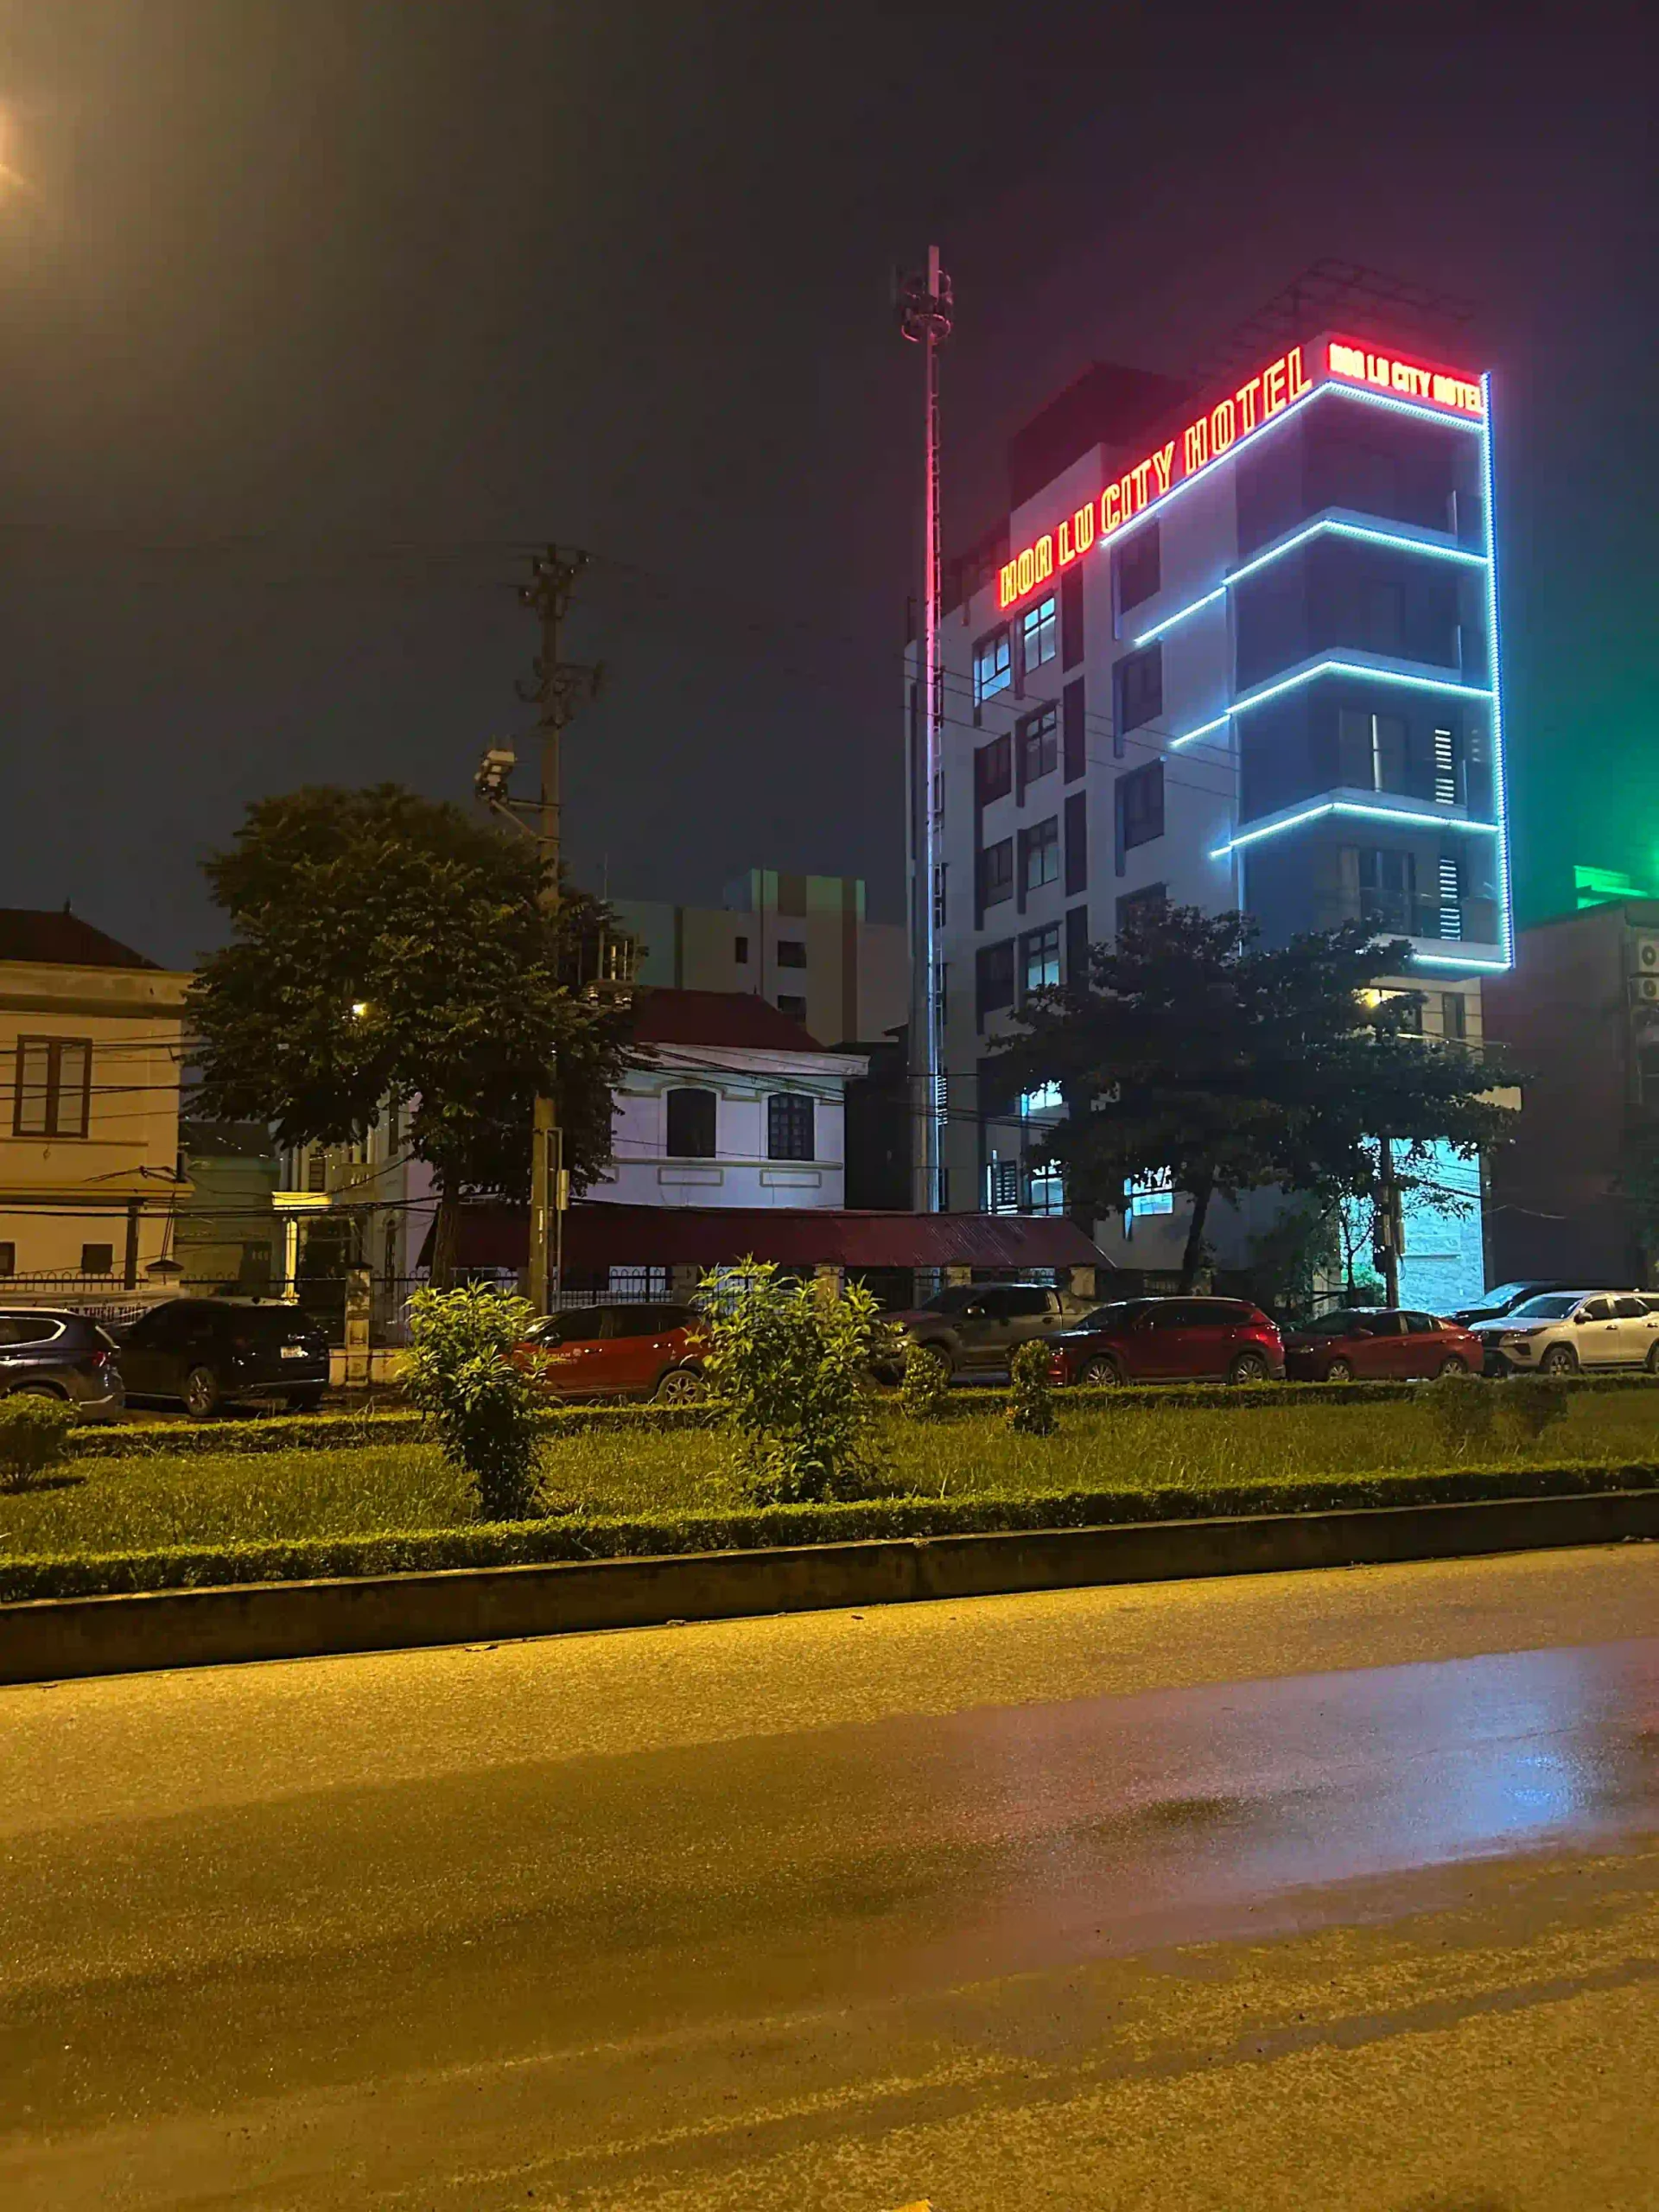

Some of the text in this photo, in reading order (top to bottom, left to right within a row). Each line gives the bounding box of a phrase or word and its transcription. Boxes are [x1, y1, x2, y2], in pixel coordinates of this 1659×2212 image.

[1367, 354, 1389, 386] LU
[1391, 361, 1432, 397] CITY
[1000, 346, 1313, 608] HOA LU CITY HOTEL
